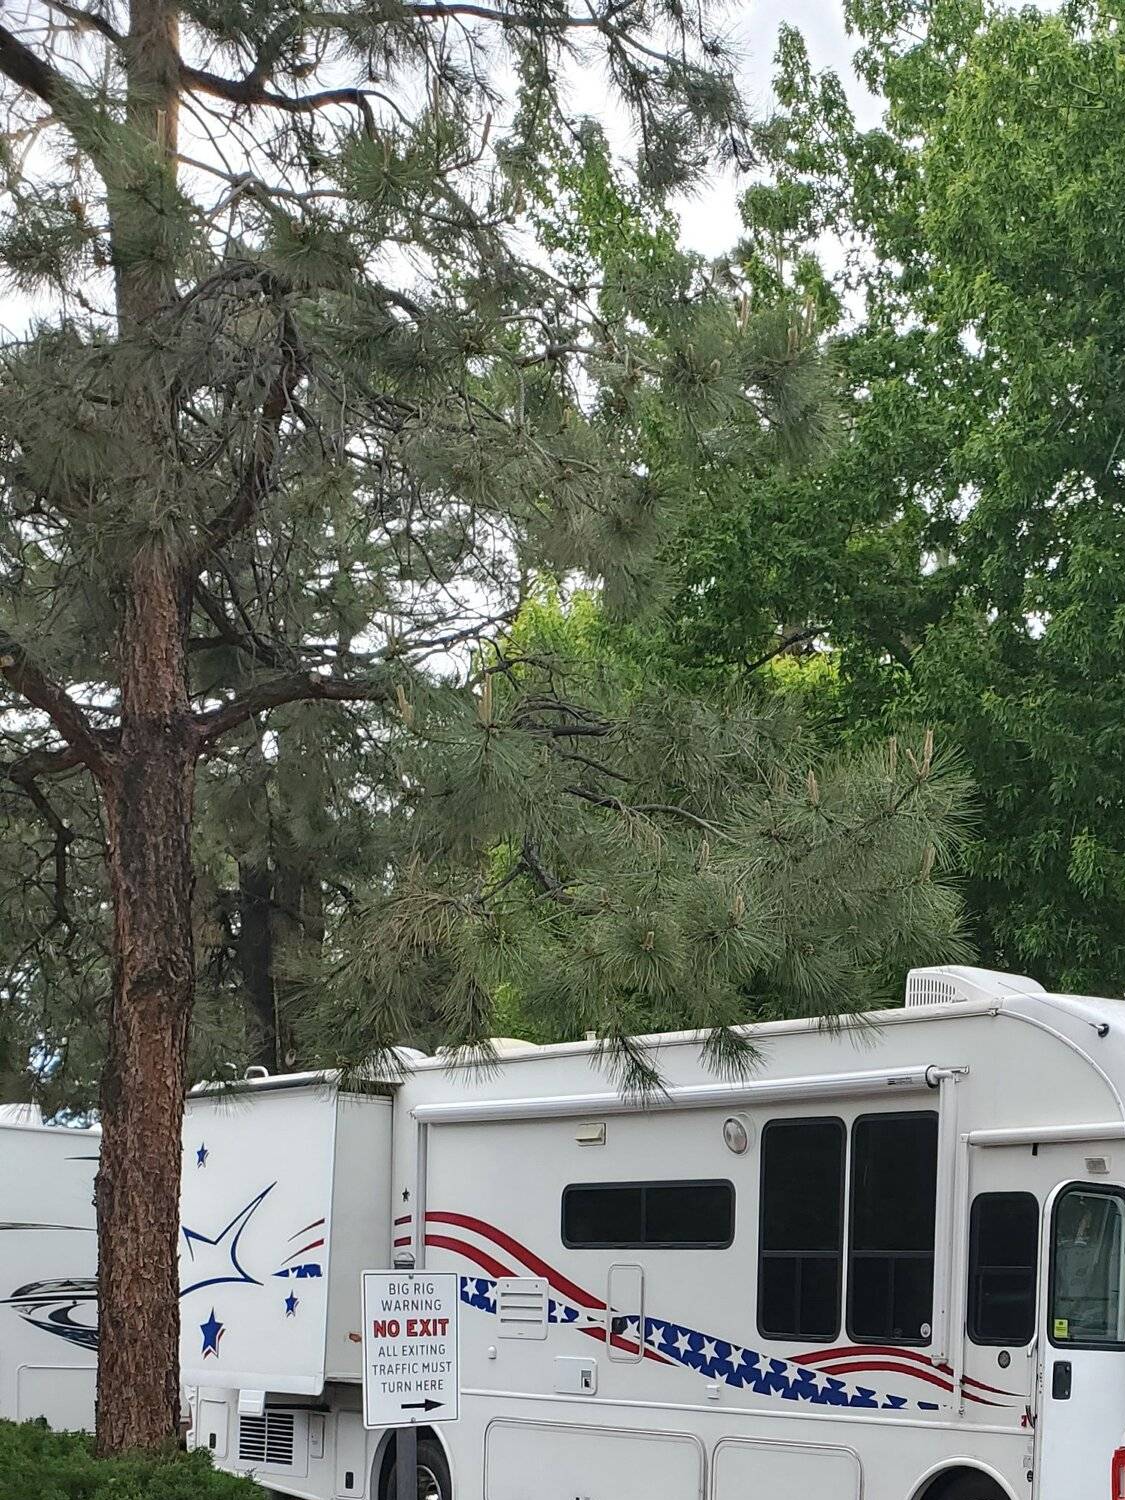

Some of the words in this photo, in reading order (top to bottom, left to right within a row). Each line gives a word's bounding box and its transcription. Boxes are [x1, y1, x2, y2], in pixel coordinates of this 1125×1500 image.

[388, 1283, 409, 1295] BIG
[414, 1283, 434, 1295] RIG
[381, 1299, 442, 1312] WARNING
[373, 1320, 400, 1338] NO
[406, 1318, 450, 1337] EXIT
[378, 1346, 397, 1357] ALL
[402, 1344, 446, 1356] EXITING
[372, 1363, 418, 1375] TRAFFIC
[422, 1361, 452, 1374] MUST
[381, 1382, 412, 1393] TURN
[416, 1380, 443, 1391] HERE
